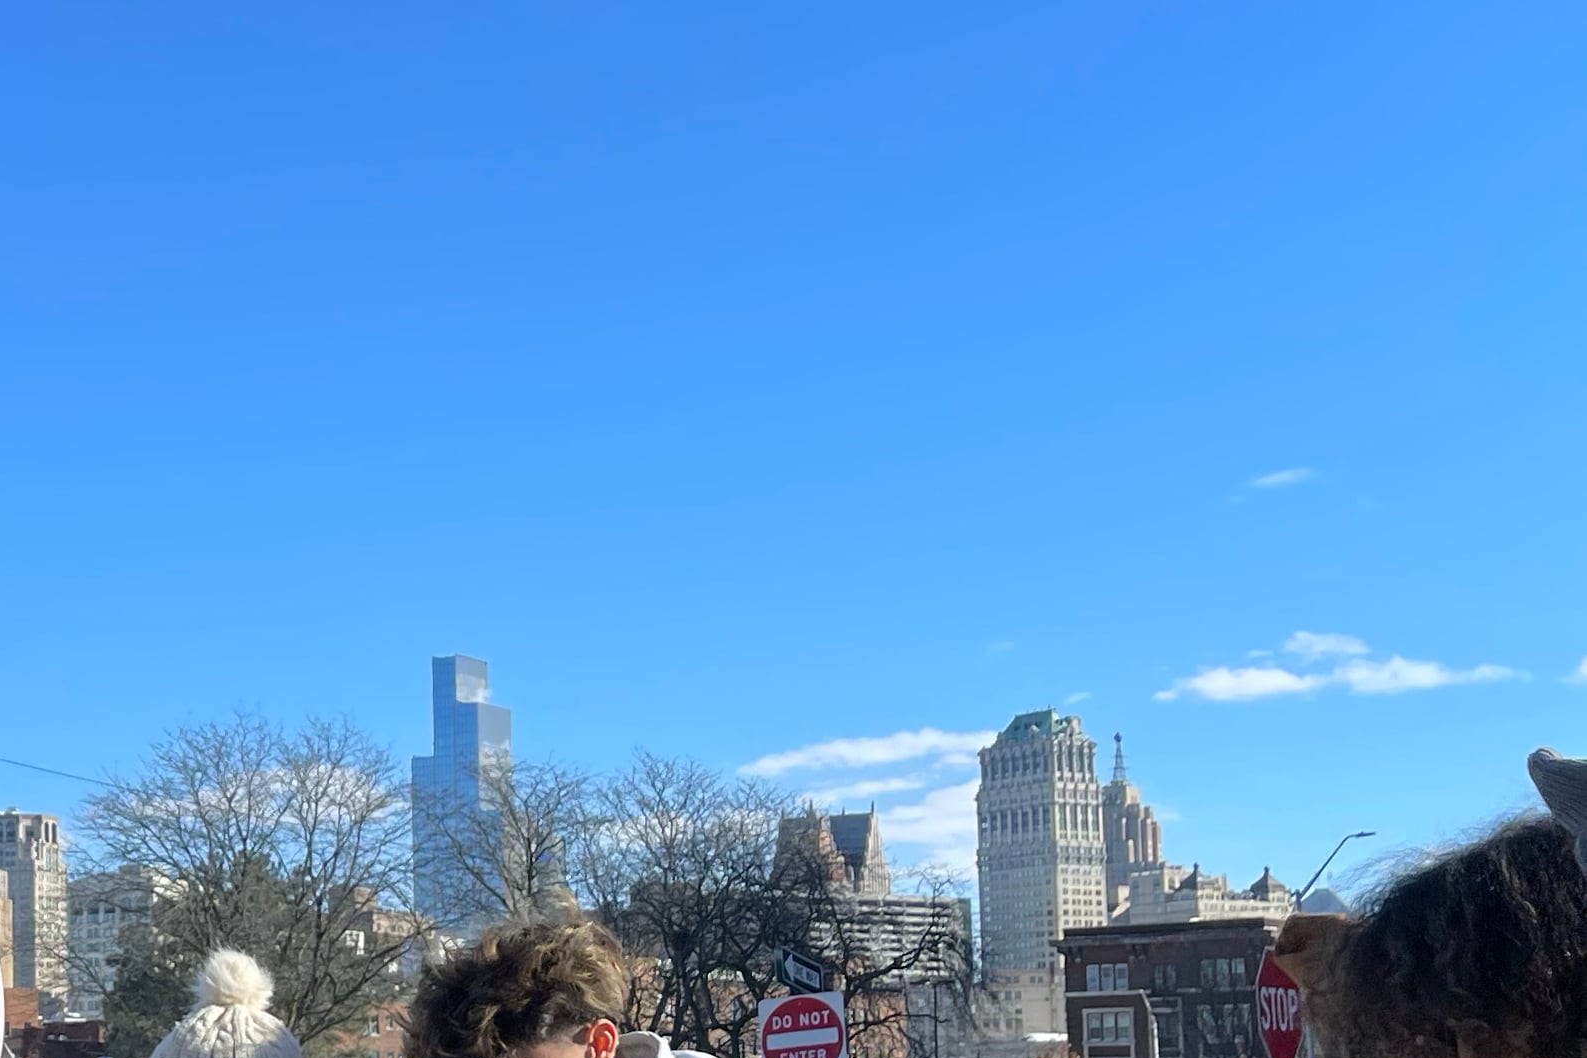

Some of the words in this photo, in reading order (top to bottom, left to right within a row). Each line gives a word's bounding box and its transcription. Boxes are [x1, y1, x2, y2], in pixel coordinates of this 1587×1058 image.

[772, 1016, 792, 1030] DO
[799, 1010, 830, 1026] NOT
[1260, 986, 1298, 1032] STOP
